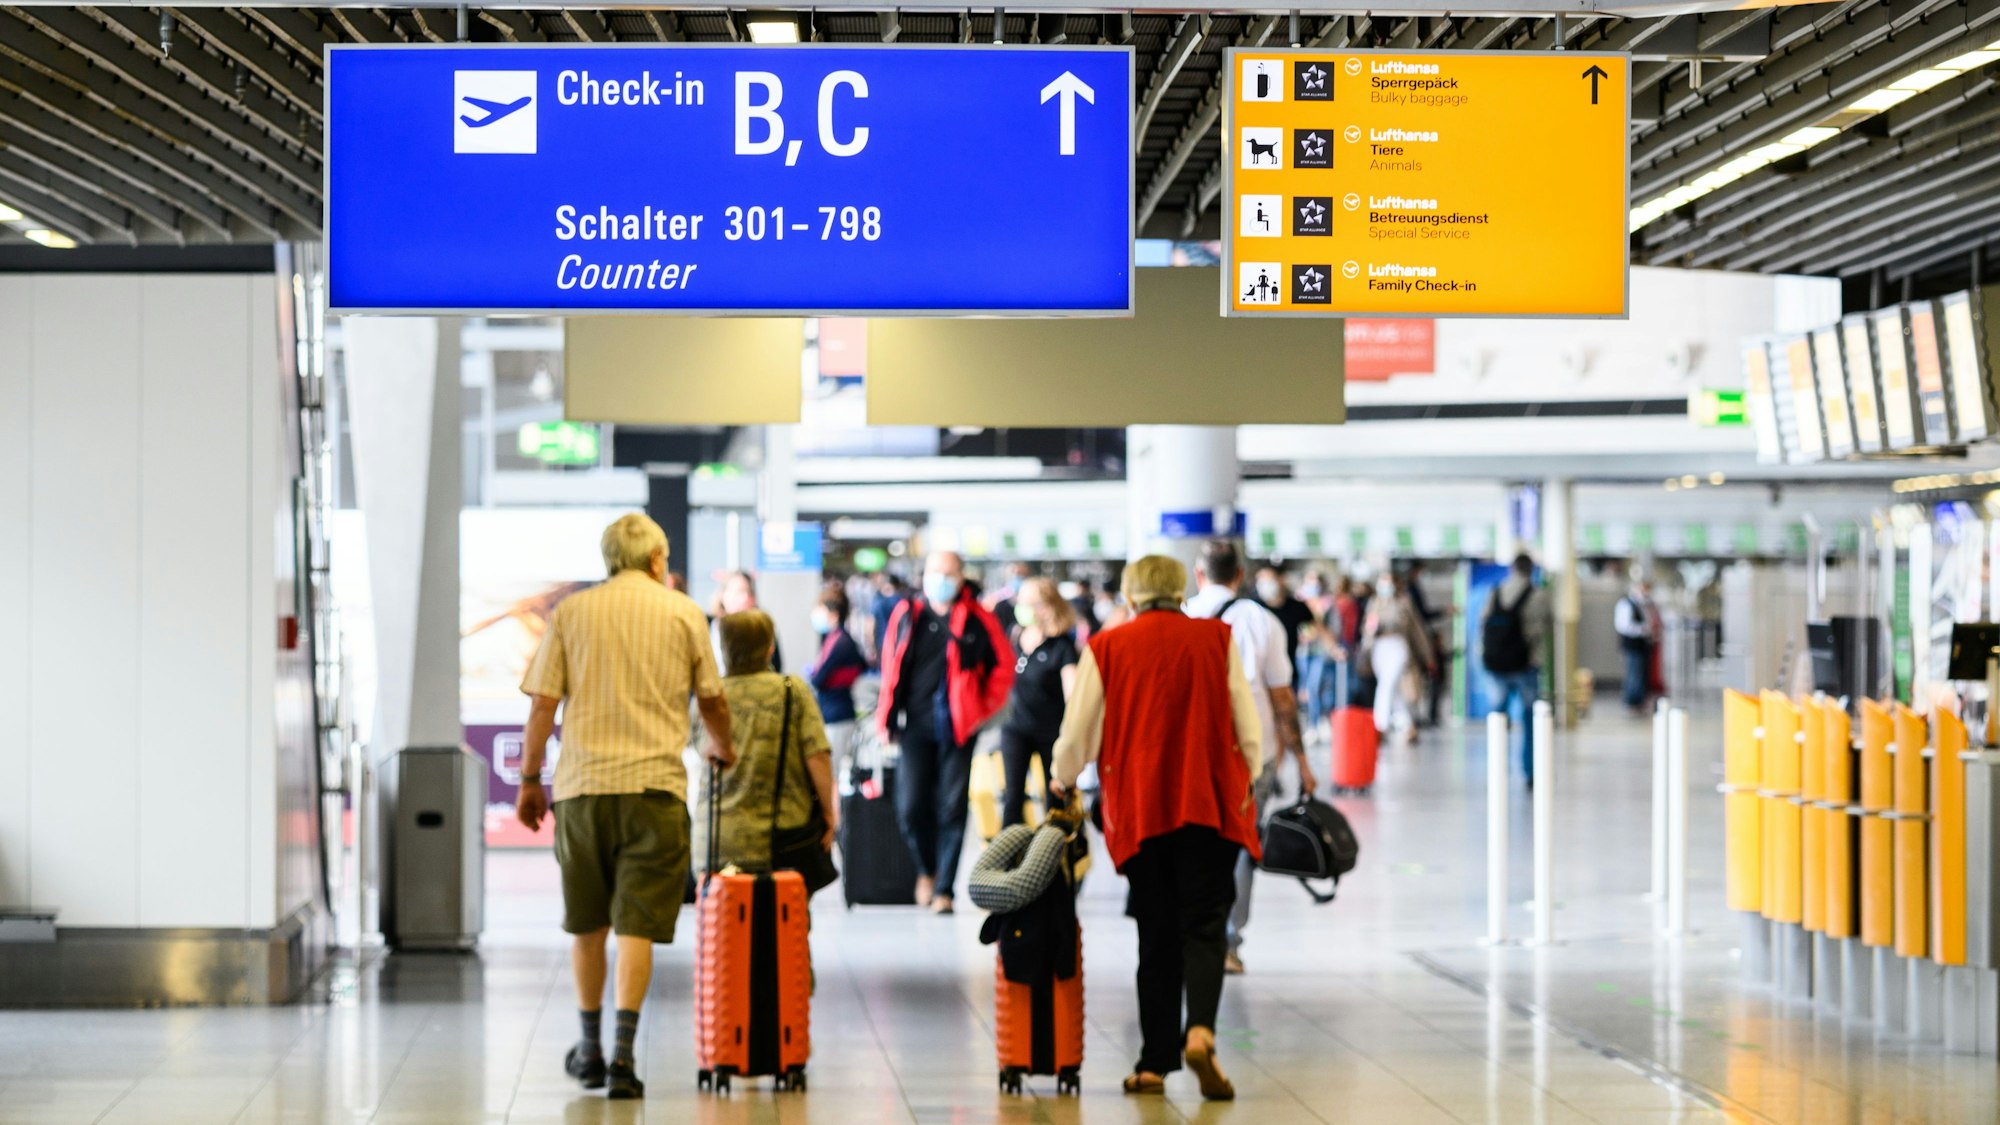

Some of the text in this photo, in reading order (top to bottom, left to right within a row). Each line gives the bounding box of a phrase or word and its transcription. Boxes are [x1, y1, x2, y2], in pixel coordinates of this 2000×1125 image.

[1371, 60, 1440, 75] Lufthansa
[557, 69, 704, 106] Check-in
[1371, 76, 1458, 91] Sperrgepäck
[1371, 91, 1469, 107] Bulky baggage
[1370, 129, 1438, 142] Lufthansa
[1370, 145, 1404, 156] Tiere
[1370, 159, 1423, 171] Animals
[1369, 196, 1438, 210] Lufthansa
[556, 204, 704, 241] Schalter
[1369, 212, 1489, 226] Betreuungsdienst
[1369, 226, 1470, 241] Special Service
[557, 254, 698, 290] Counter
[1368, 263, 1437, 278] Lufthansa
[1368, 280, 1477, 293] Family Check-in
